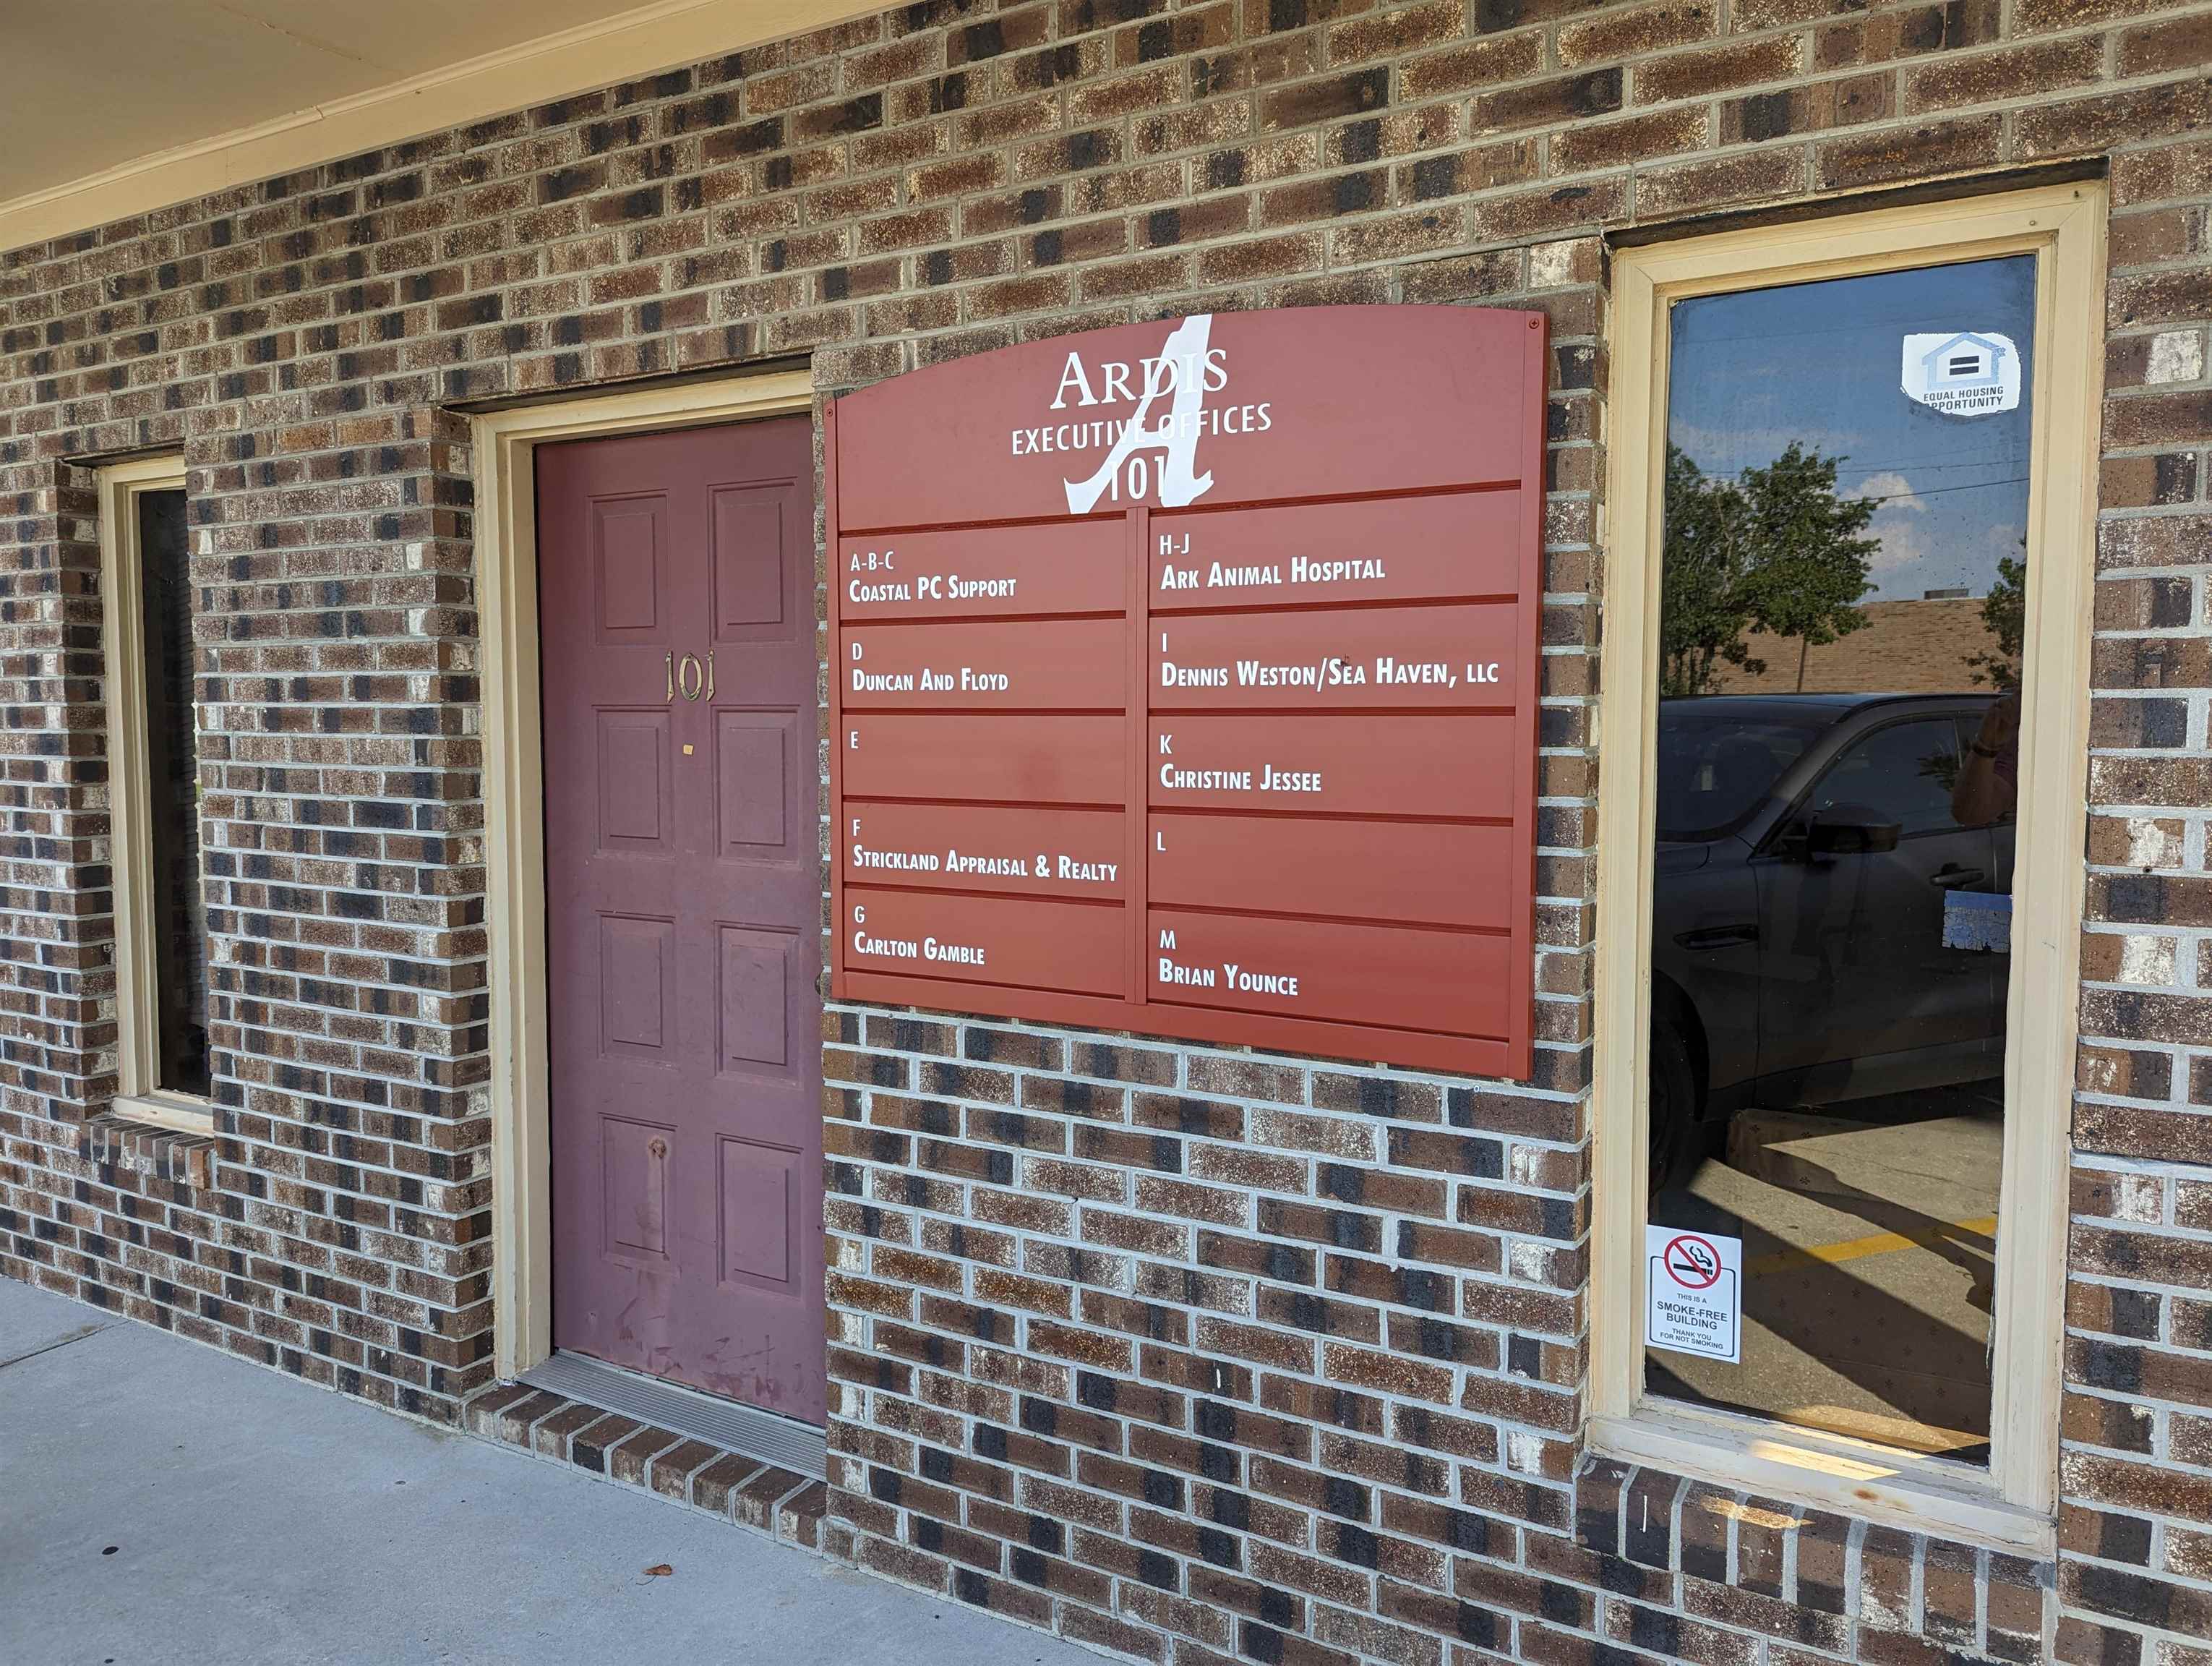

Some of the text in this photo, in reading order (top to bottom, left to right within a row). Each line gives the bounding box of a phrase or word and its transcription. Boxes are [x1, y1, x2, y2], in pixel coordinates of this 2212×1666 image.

[1050, 349, 1228, 409] ARDIS
[1924, 386, 2003, 401] EQUAL HOUSING
[1924, 396, 2003, 411] PPORTUNITY
[1012, 403, 1272, 456] EXECUTIVE OFFICES
[1110, 456, 1165, 501] 101
[1159, 533, 1190, 555] H-J
[850, 551, 894, 571] A-B-C
[1160, 556, 1386, 590] ARK ANIMAL HOSPITAL
[849, 575, 1016, 602] COASTAL PC SUPPORT
[852, 642, 862, 660] D
[665, 650, 716, 704] 101
[852, 667, 1008, 691] DUNCAN AND FLOYD
[1162, 662, 1228, 687] DENNIS
[1467, 663, 1499, 683] LLC
[850, 731, 859, 749] E
[1160, 734, 1173, 754] K
[1160, 763, 1322, 792] CHRISTINE JESSEE
[853, 819, 862, 837] F
[1157, 832, 1167, 851] L
[853, 845, 1118, 881] STRICKLAND APPRAISAL & REALTY
[854, 905, 865, 923] G
[854, 931, 985, 965] CARLTON GAMBLE
[1159, 929, 1176, 949] M
[1159, 958, 1298, 996] BRIAN YOUNCE
[1657, 1301, 1728, 1322] SMOKE-FREE
[1666, 1313, 1718, 1330] BUILDING
[1672, 1328, 1695, 1338] THANK
[1692, 1338, 1724, 1349] SMOKING
